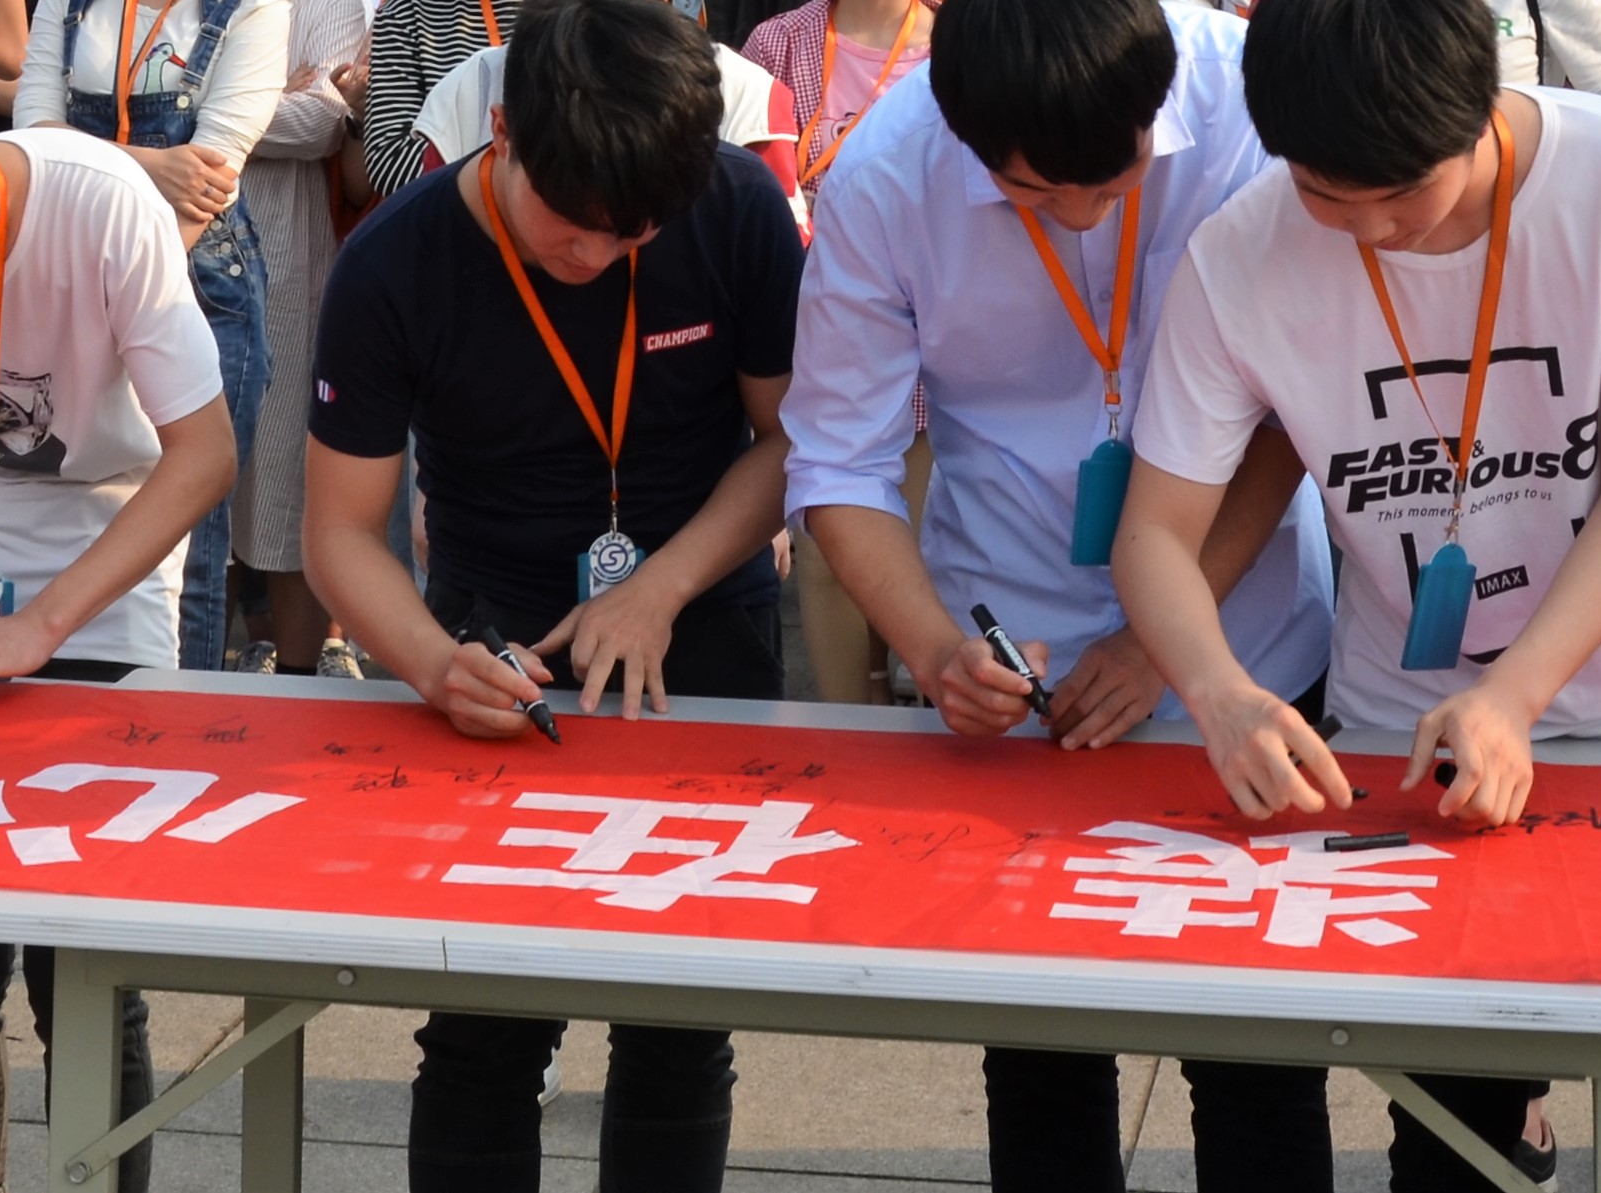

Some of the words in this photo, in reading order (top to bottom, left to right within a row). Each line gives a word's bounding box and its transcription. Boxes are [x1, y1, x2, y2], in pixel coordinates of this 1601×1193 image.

[1472, 439, 1485, 459] &
[1377, 508, 1404, 523] This
[1407, 506, 1465, 518] momen,
[1469, 489, 1521, 514] belongs
[1524, 487, 1537, 499] to
[1540, 491, 1553, 501] us
[1481, 570, 1523, 596] IMAX
